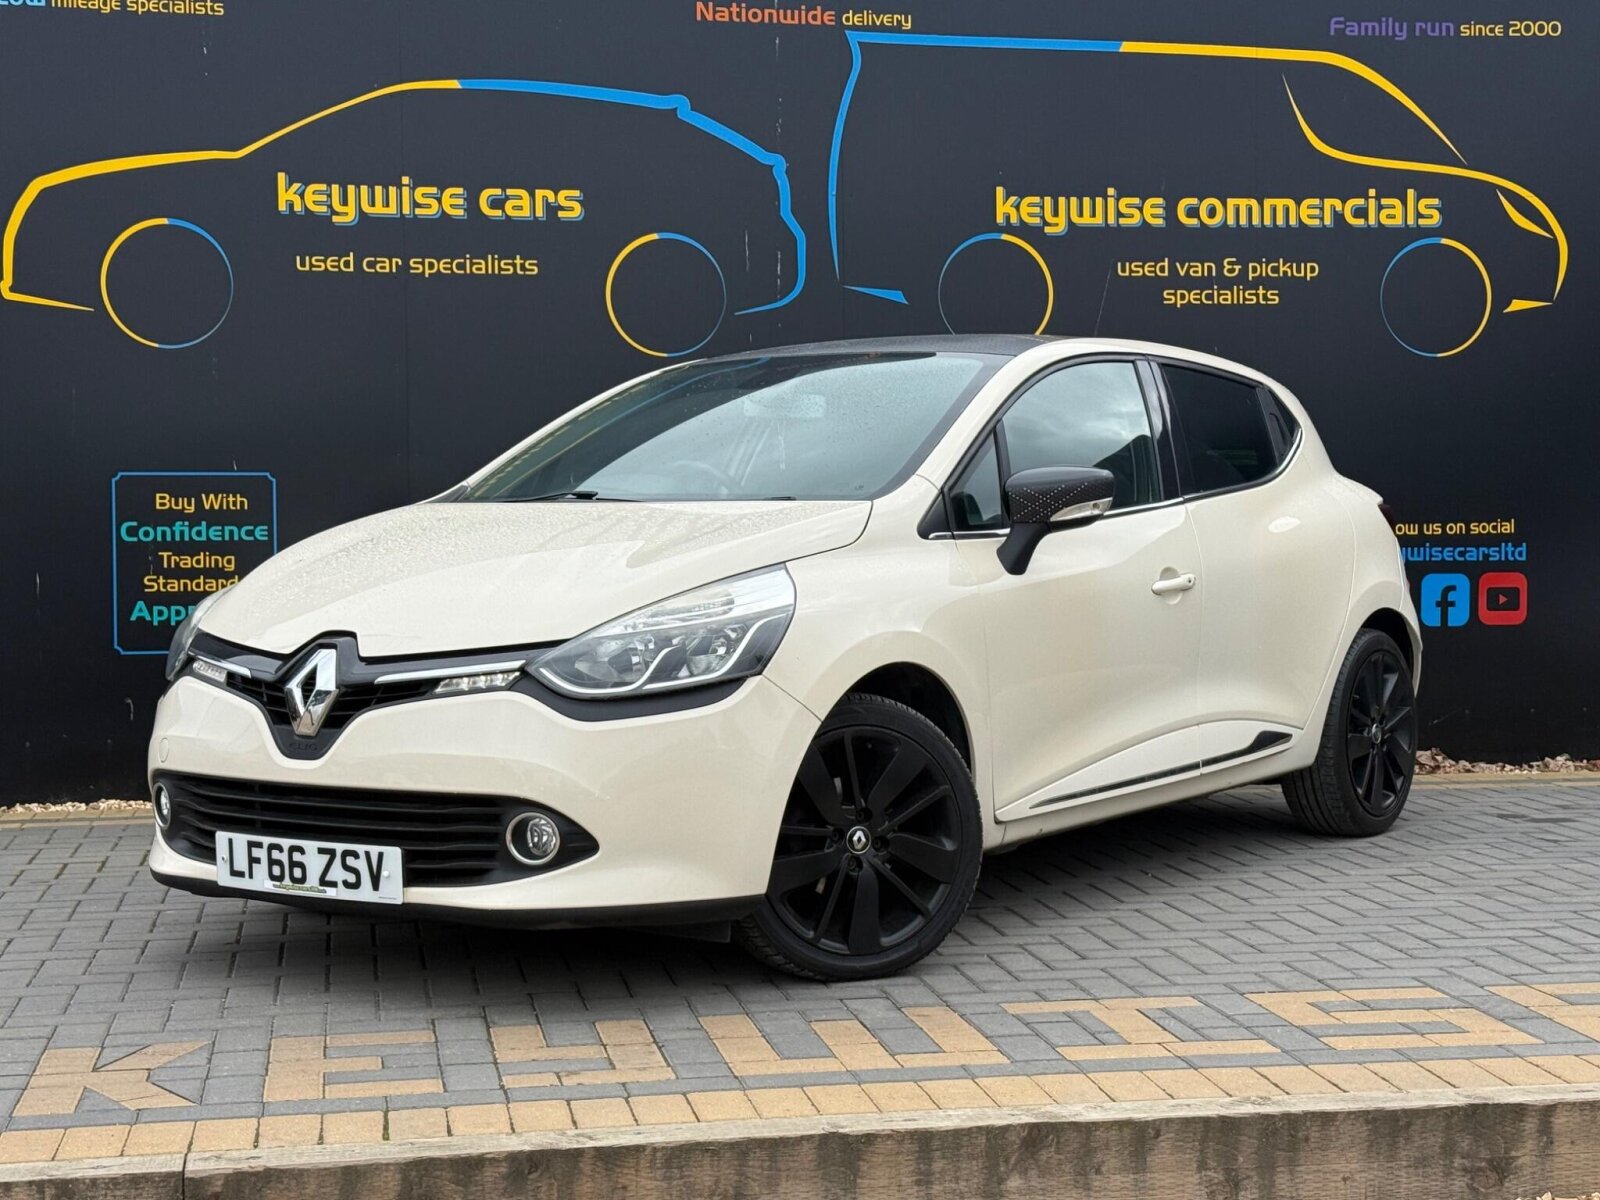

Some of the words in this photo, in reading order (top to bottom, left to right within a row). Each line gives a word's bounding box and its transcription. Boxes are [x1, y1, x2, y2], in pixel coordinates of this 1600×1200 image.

[126, 0, 225, 16] specialists
[695, 1, 836, 26] Nationwide
[842, 9, 912, 30] delivery
[1329, 16, 1408, 41] Family
[1415, 20, 1455, 37] run
[1460, 21, 1504, 37] since
[1508, 20, 1562, 37] 2000
[276, 171, 467, 226] keywise
[479, 186, 585, 222] cars
[995, 185, 1166, 237] keywise
[1176, 187, 1443, 229] commercials
[295, 251, 354, 273] used
[362, 255, 402, 273] car
[409, 253, 539, 278] specialists
[1117, 257, 1169, 278] used
[1176, 261, 1217, 278] van
[1222, 258, 1242, 276] &
[1247, 257, 1320, 281] pickup
[1162, 284, 1280, 308] specialists
[155, 492, 196, 513] Buy
[201, 492, 248, 511] With
[120, 521, 269, 542] Confidence
[1395, 522, 1419, 535] ow
[1423, 522, 1442, 535] us
[1446, 522, 1466, 535] on
[1470, 518, 1515, 534] social
[158, 551, 236, 572] Trading
[227, 837, 308, 885] LF66
[317, 847, 384, 892] ZSV
